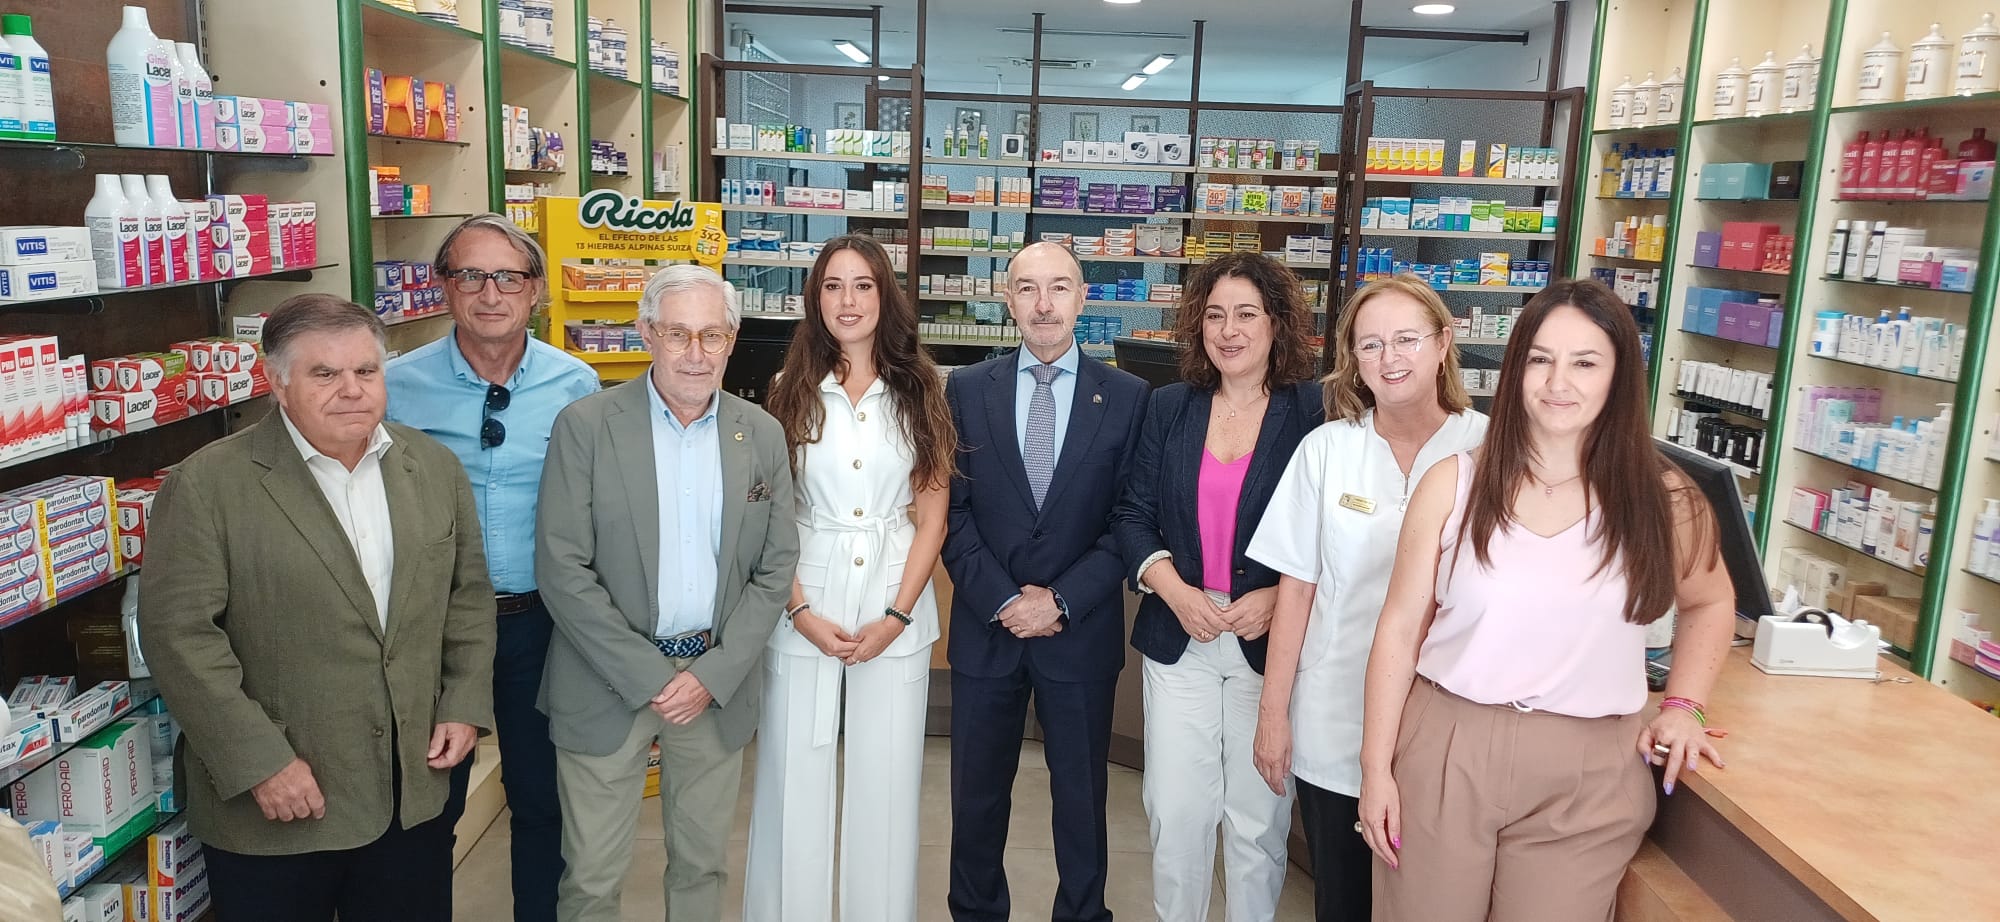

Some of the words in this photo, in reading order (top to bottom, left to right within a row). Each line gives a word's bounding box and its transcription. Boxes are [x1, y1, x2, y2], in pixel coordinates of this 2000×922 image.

[146, 62, 171, 77] Lace
[195, 87, 212, 98] Lace
[582, 193, 694, 229] Ricola
[145, 221, 162, 232] Lace
[700, 229, 721, 242] 3x2
[18, 241, 45, 251] VITIS
[629, 243, 665, 251] ALPINAS
[30, 276, 55, 286] VITIS
[236, 327, 259, 335] Lacer
[142, 370, 161, 381] Lacer
[229, 379, 250, 392] Lacer
[127, 399, 153, 414] Lacer
[46, 492, 82, 510] parodontax
[49, 516, 85, 535] parodontax
[53, 540, 88, 558] parodontax
[0, 566, 17, 579] ontax
[56, 564, 90, 585] parodontax
[77, 701, 110, 727] parodontax
[15, 781, 28, 816] PERIO
